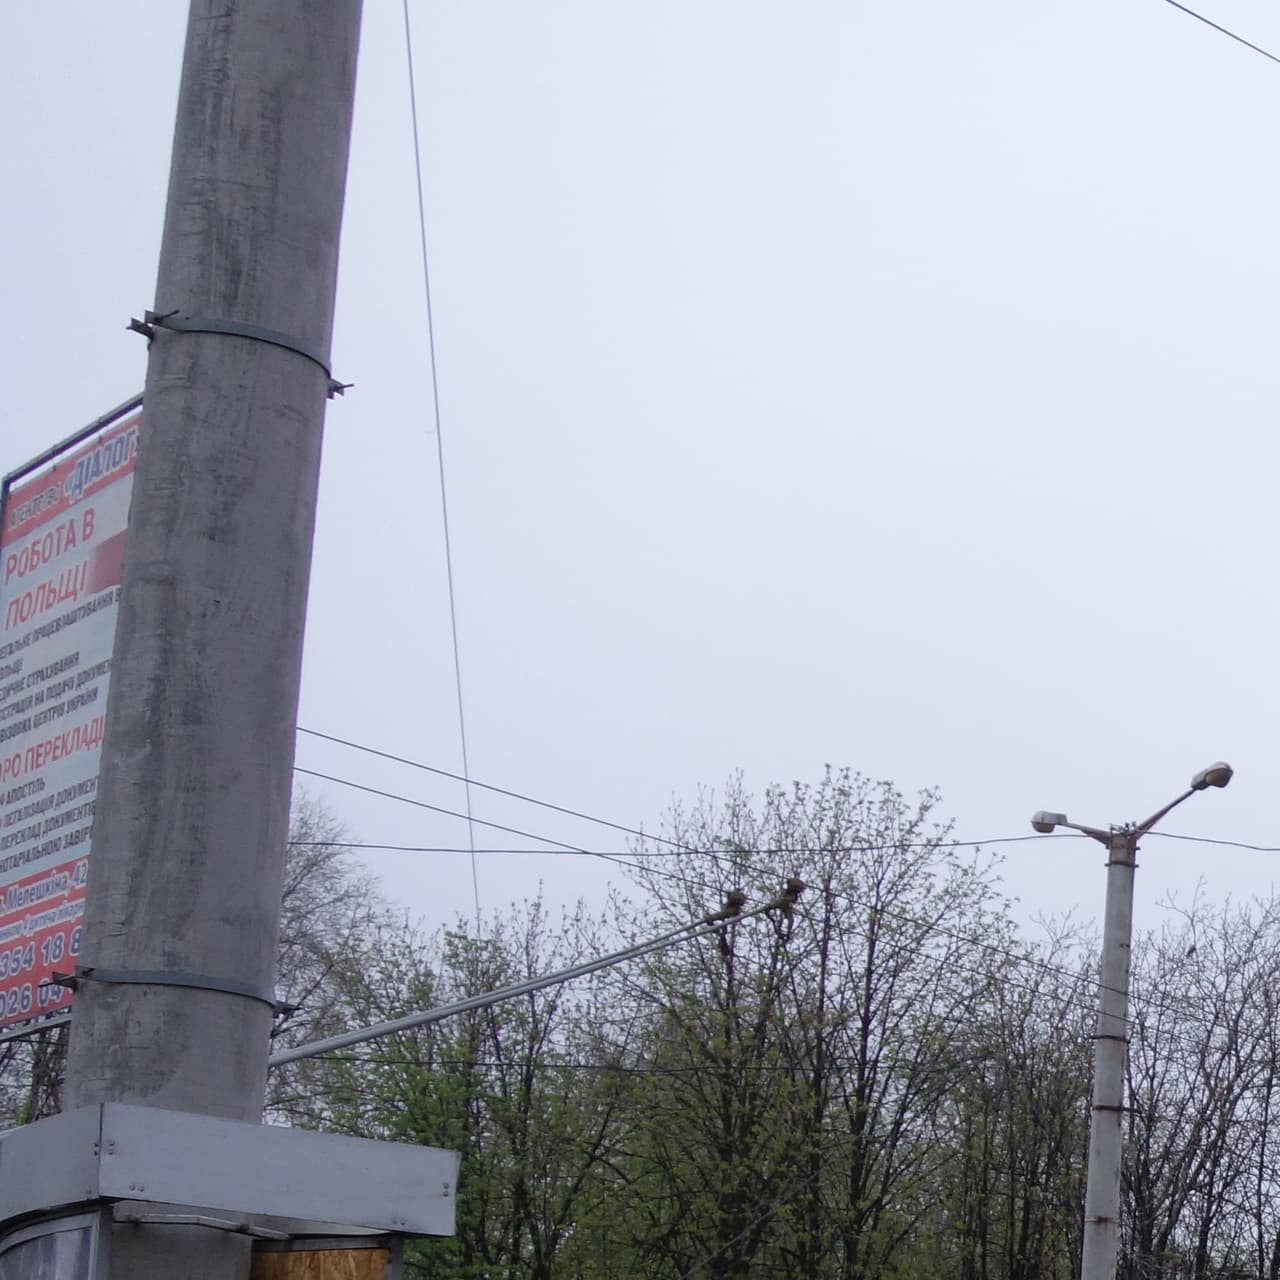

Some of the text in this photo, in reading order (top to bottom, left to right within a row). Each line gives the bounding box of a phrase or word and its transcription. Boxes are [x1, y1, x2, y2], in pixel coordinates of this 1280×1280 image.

[5, 508, 94, 586] РОБОТА В
[6, 560, 87, 632] ПОЛЬЩІ
[25, 714, 104, 773] ПЕРЕКЛАДІ
[42, 932, 65, 964] 18
